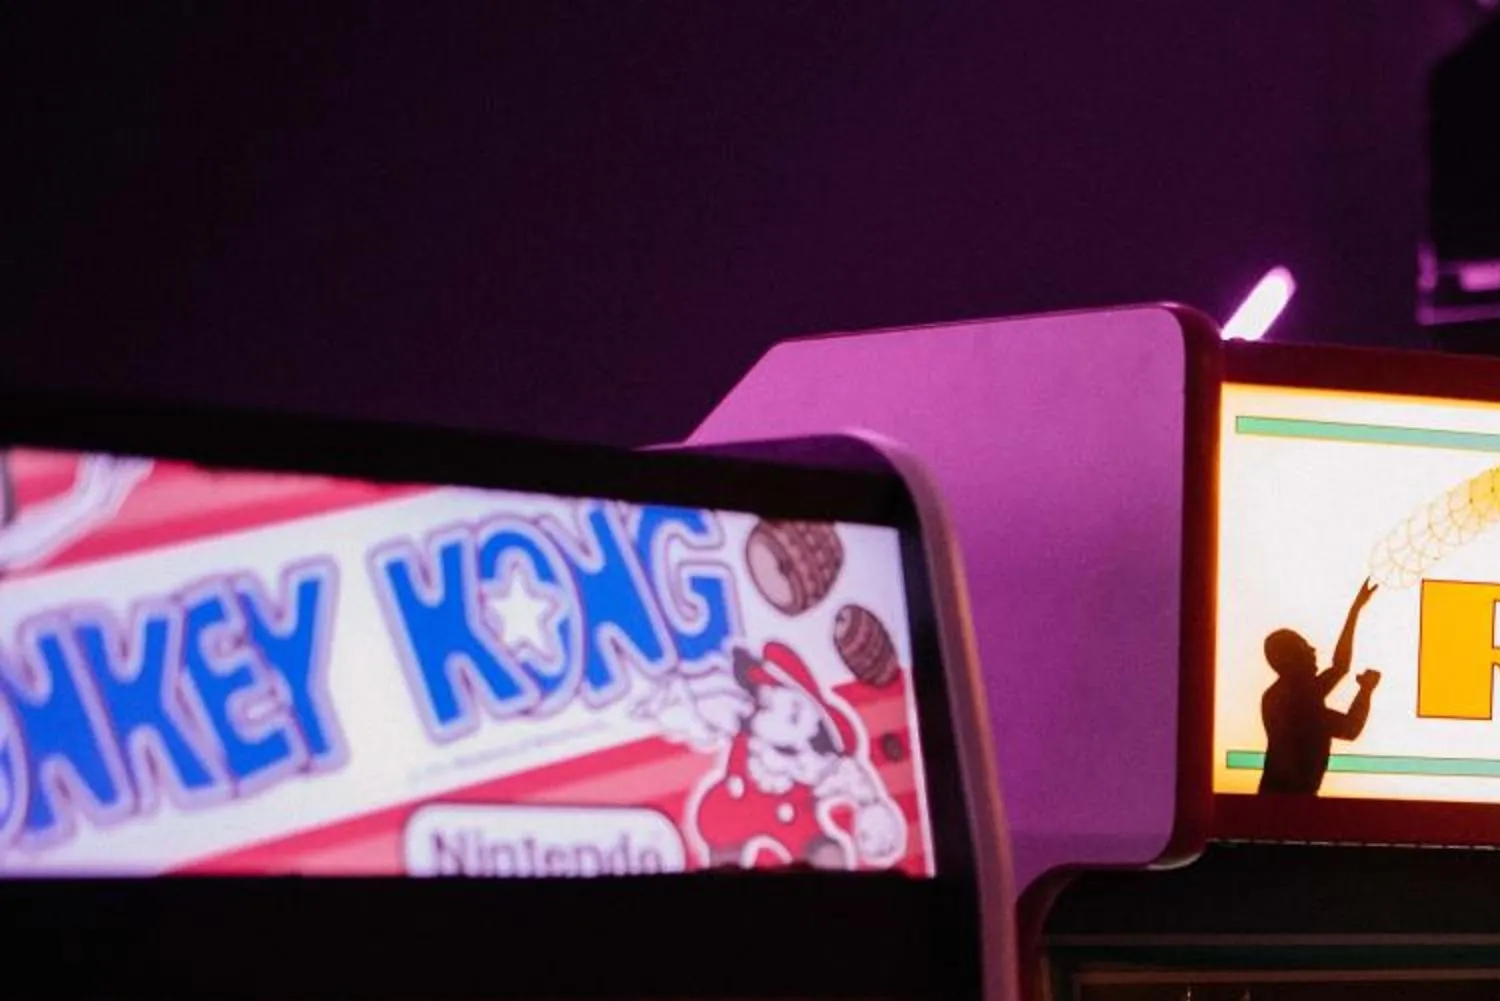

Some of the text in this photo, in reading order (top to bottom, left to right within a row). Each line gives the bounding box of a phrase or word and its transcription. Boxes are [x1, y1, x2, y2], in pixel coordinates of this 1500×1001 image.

[0, 503, 743, 850] NKEY KONG
[430, 828, 664, 876] Nintendo
